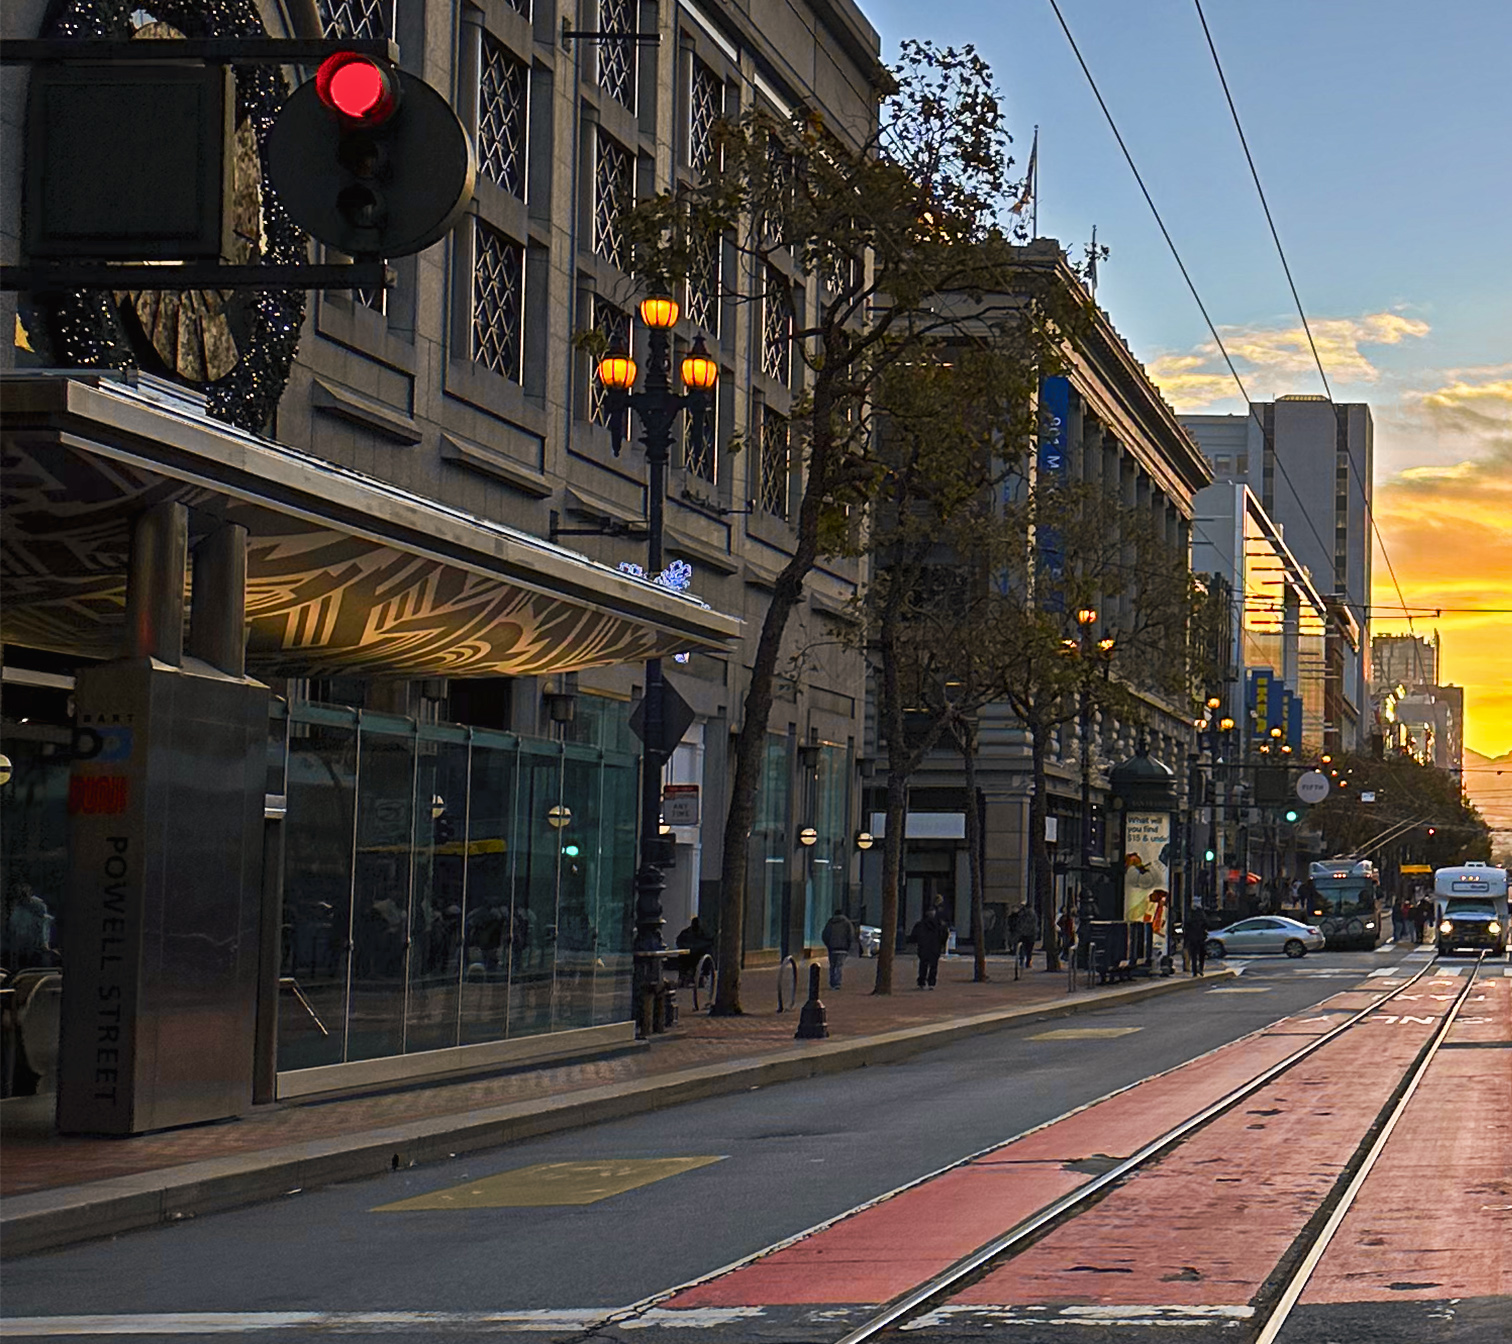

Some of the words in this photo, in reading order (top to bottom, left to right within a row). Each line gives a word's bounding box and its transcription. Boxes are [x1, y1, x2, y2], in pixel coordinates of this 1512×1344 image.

[83, 714, 134, 723] BART
[1256, 678, 1268, 734] IKEA
[1128, 826, 1142, 834] you
[1143, 825, 1158, 833] find
[101, 836, 129, 971] POWELL
[93, 985, 121, 1106] STREET
